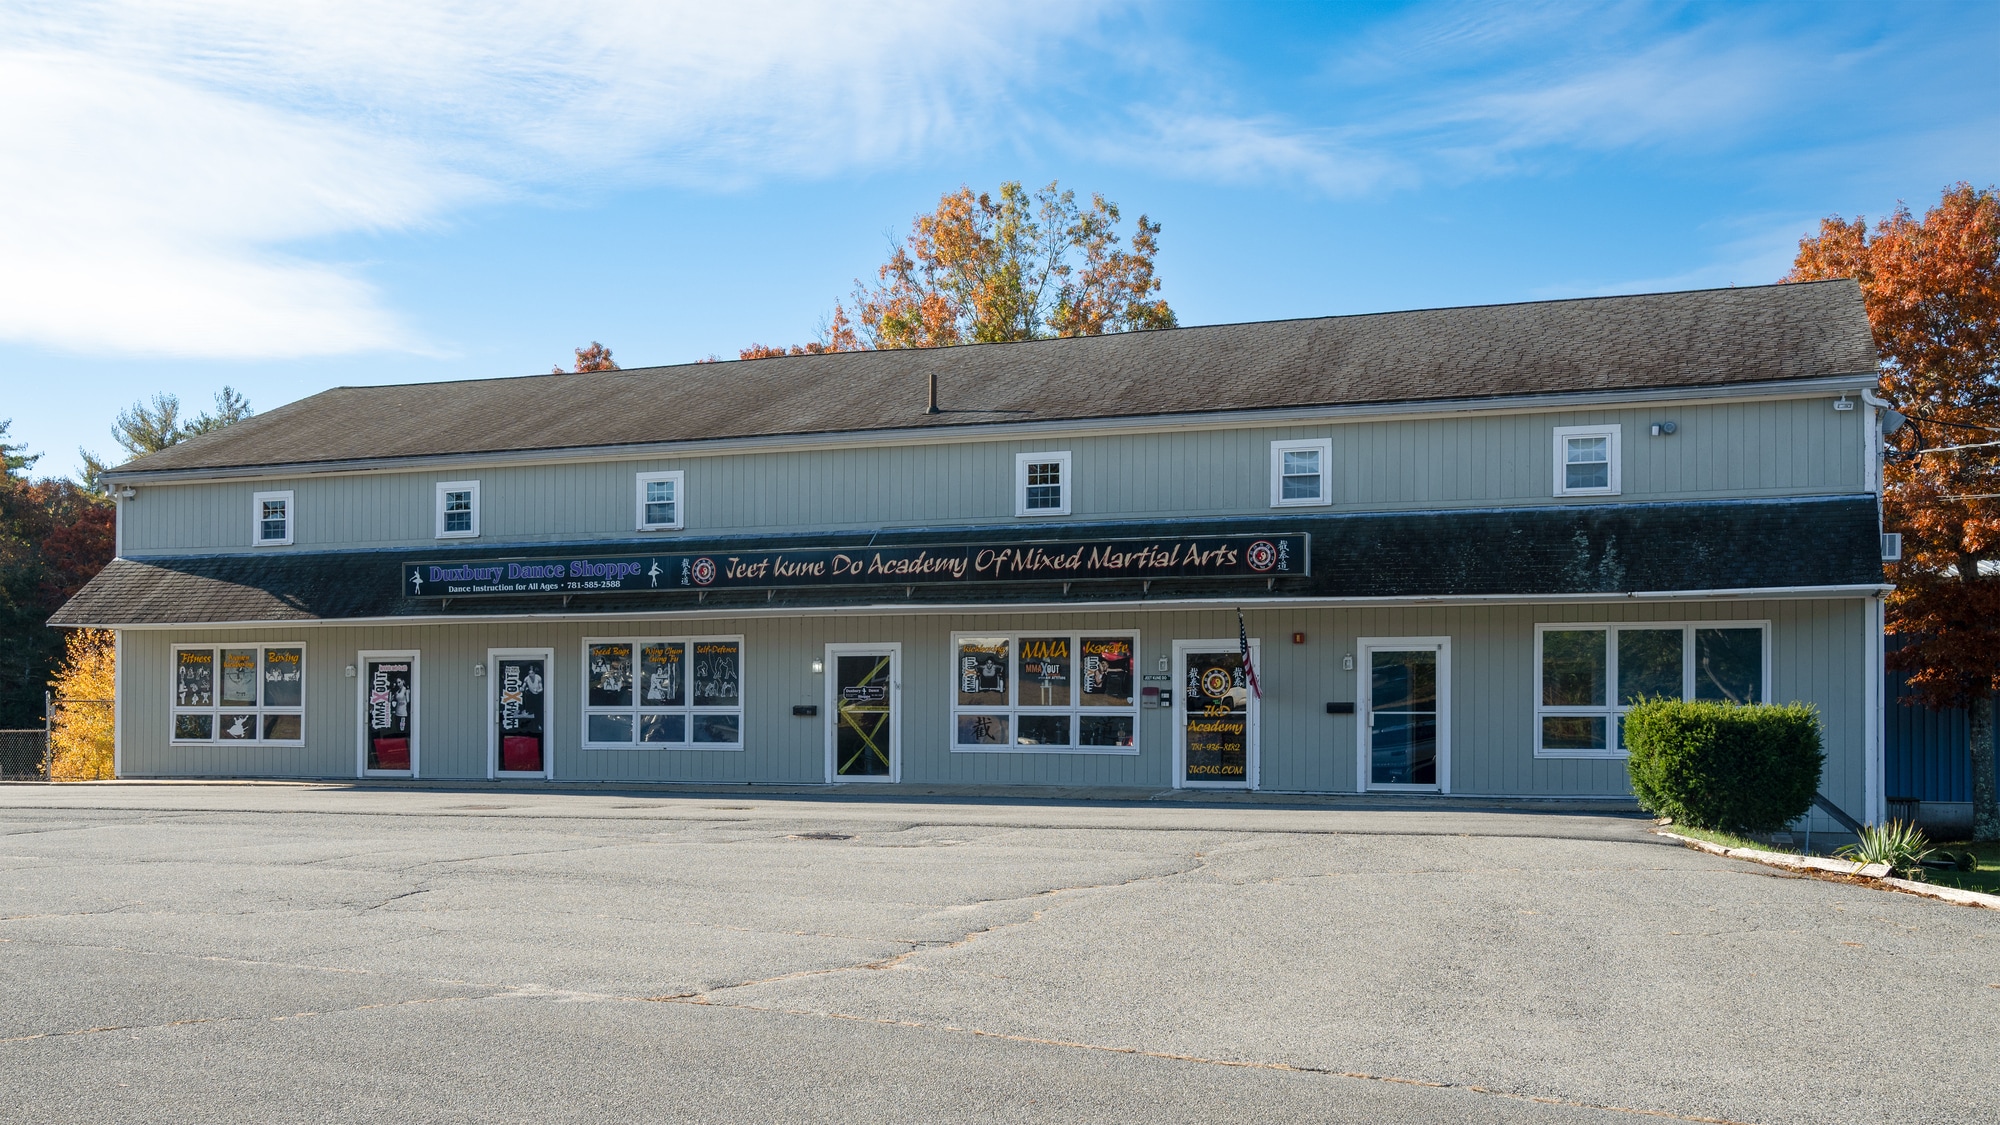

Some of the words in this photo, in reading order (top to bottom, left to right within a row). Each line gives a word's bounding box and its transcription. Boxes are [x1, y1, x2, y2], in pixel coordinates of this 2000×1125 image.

[726, 556, 769, 579] Jeet
[831, 554, 864, 576] Do
[867, 550, 968, 578] Academy
[975, 549, 1012, 578] Of
[1011, 546, 1084, 572] Mixed
[1087, 543, 1181, 570] Martial
[1182, 543, 1238, 567] Arts
[429, 564, 504, 584] Duxbury
[508, 563, 566, 579] Dance
[569, 559, 642, 580] Shoppe
[448, 585, 471, 593] Dance
[472, 583, 514, 592] Instruction
[515, 583, 527, 591] for
[527, 582, 539, 590] All
[540, 582, 559, 591] Ages
[566, 580, 621, 589] 781-585-2588
[613, 646, 630, 656] Bags
[645, 646, 664, 656] Wing
[664, 647, 683, 655] Chun
[1021, 640, 1069, 659] MMA
[180, 652, 212, 664] Fitness
[267, 651, 299, 665] Boxing
[669, 655, 679, 663] Fu
[1187, 720, 1244, 735] Academy
